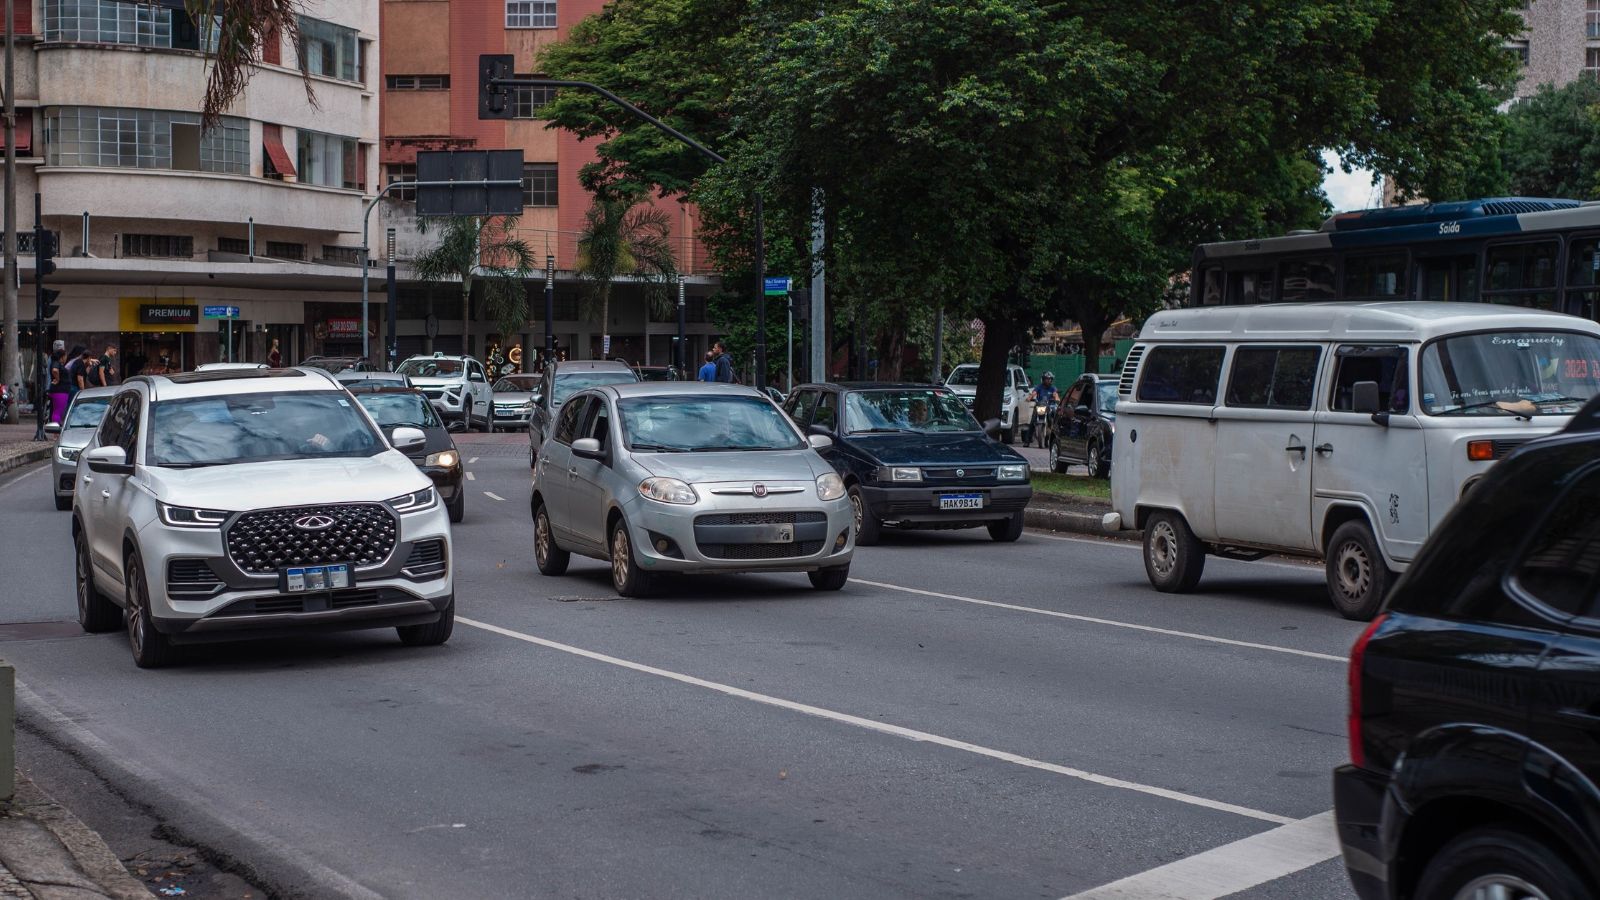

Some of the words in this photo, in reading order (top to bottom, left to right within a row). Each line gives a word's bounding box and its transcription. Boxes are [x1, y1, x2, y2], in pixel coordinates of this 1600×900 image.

[1439, 221, 1460, 234] Saída
[148, 308, 191, 317] PREMIUM
[943, 499, 978, 508] HAK9B14
